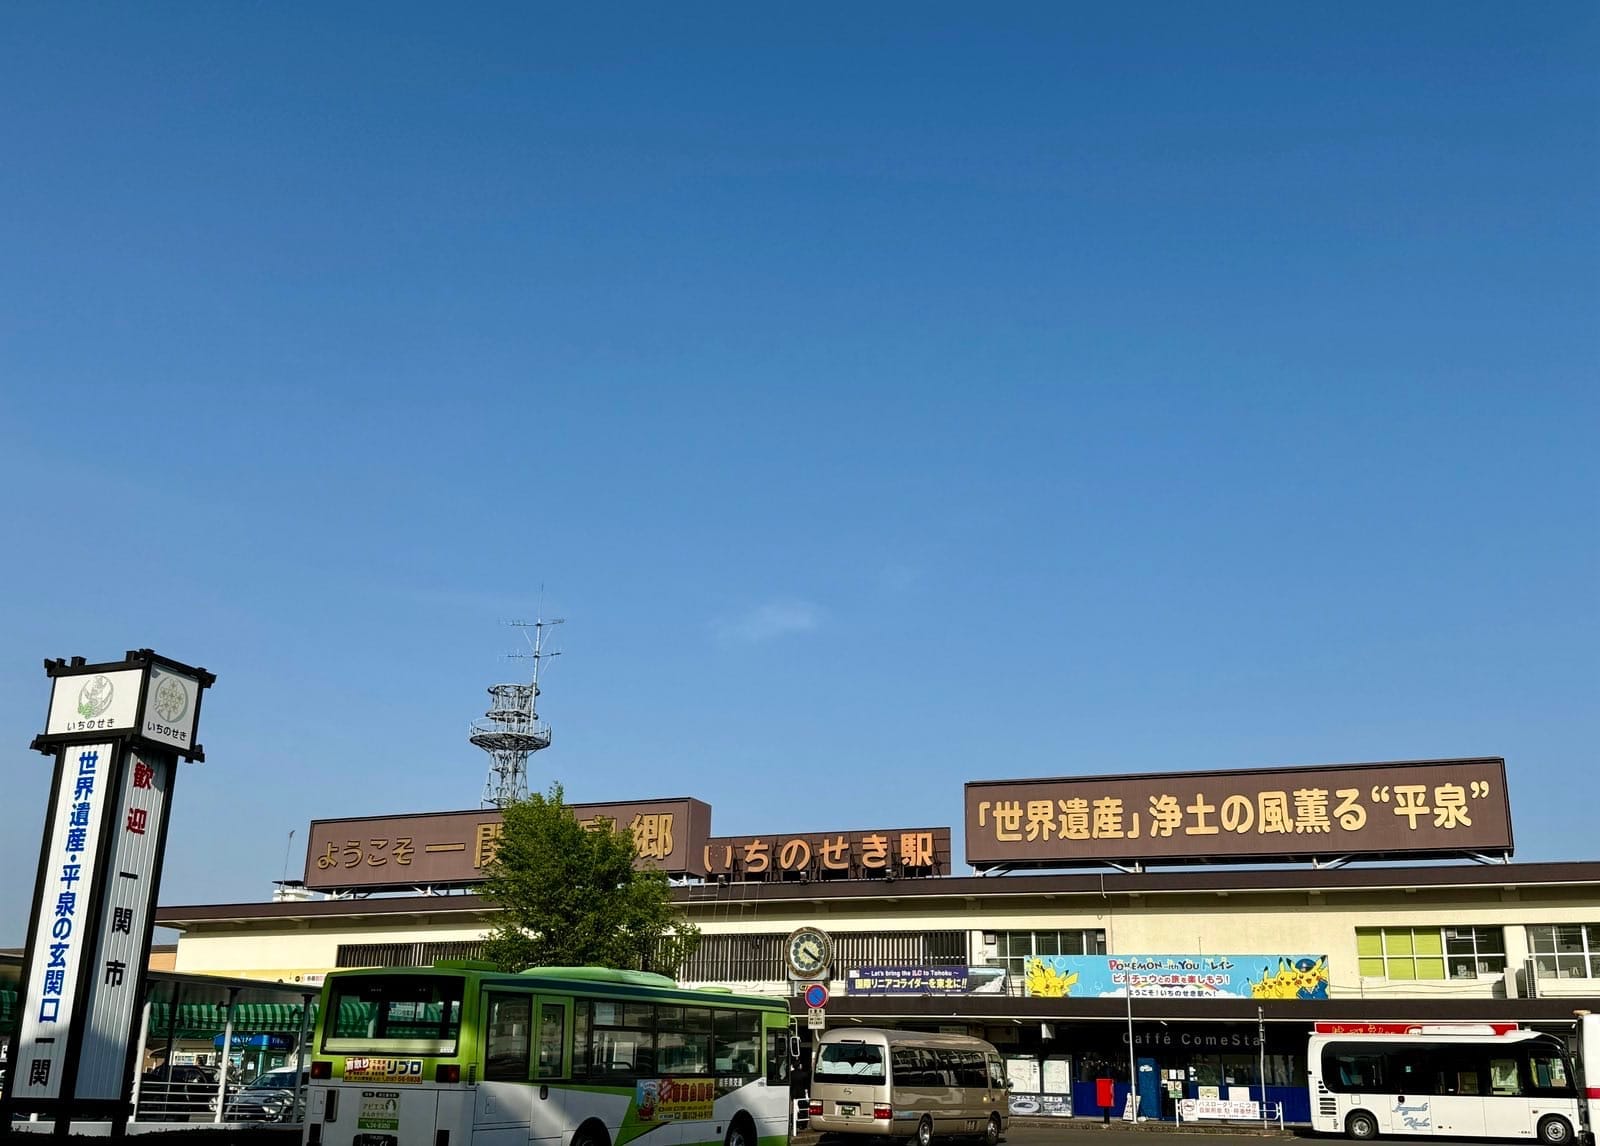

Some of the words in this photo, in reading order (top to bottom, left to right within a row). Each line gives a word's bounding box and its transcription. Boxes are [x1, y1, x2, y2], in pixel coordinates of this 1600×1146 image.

[67, 718, 115, 731] いちのせき
[147, 721, 187, 741] いちのせき
[703, 832, 934, 873] いちのせき駅
[1178, 960, 1199, 970] YOU
